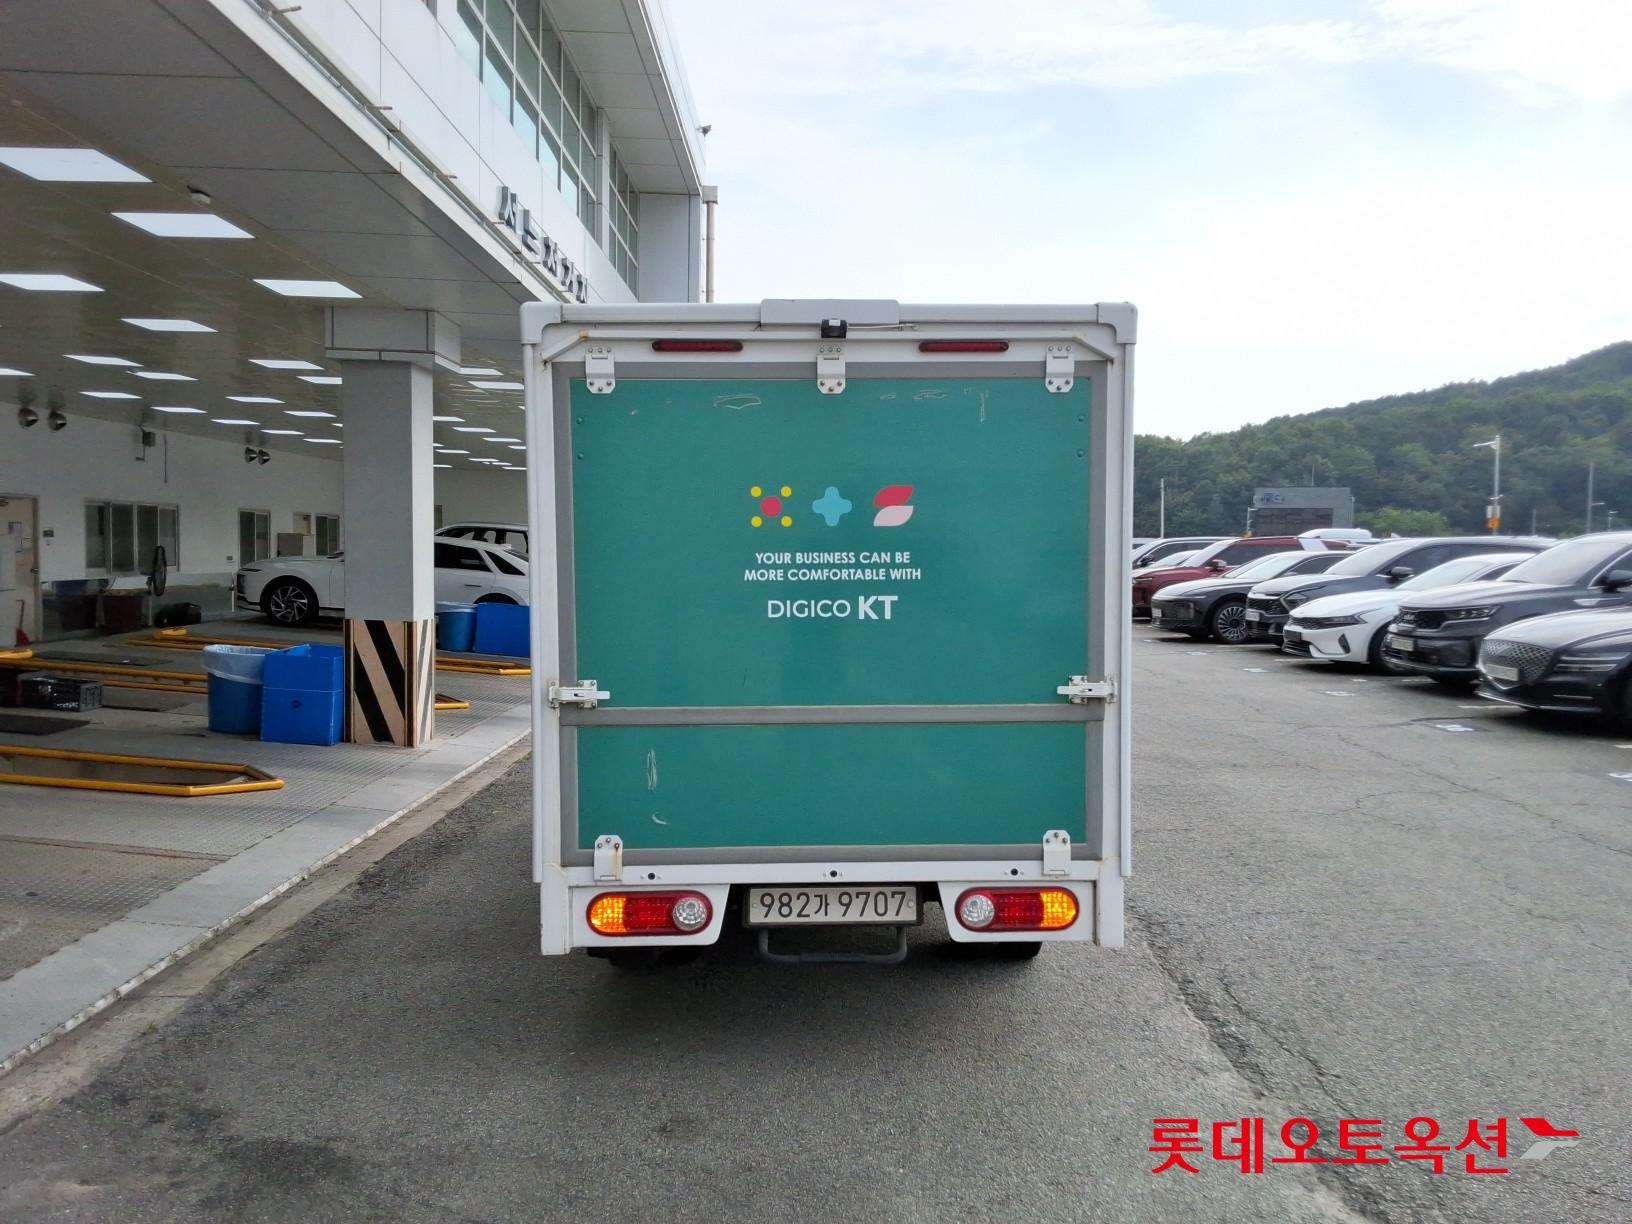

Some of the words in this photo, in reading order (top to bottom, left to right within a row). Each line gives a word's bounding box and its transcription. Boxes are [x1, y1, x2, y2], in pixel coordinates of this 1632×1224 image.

[755, 552, 792, 565] YOUR
[795, 552, 856, 564] BUSINESS
[859, 552, 891, 564] CAN
[895, 552, 911, 563] BE
[744, 569, 785, 581] MORE
[787, 569, 887, 581] COMFORTABLE
[889, 568, 922, 580] WITH
[767, 600, 851, 618] DIGICO
[858, 595, 899, 620] KT
[760, 893, 831, 919] 982가
[838, 891, 907, 918] 9707
